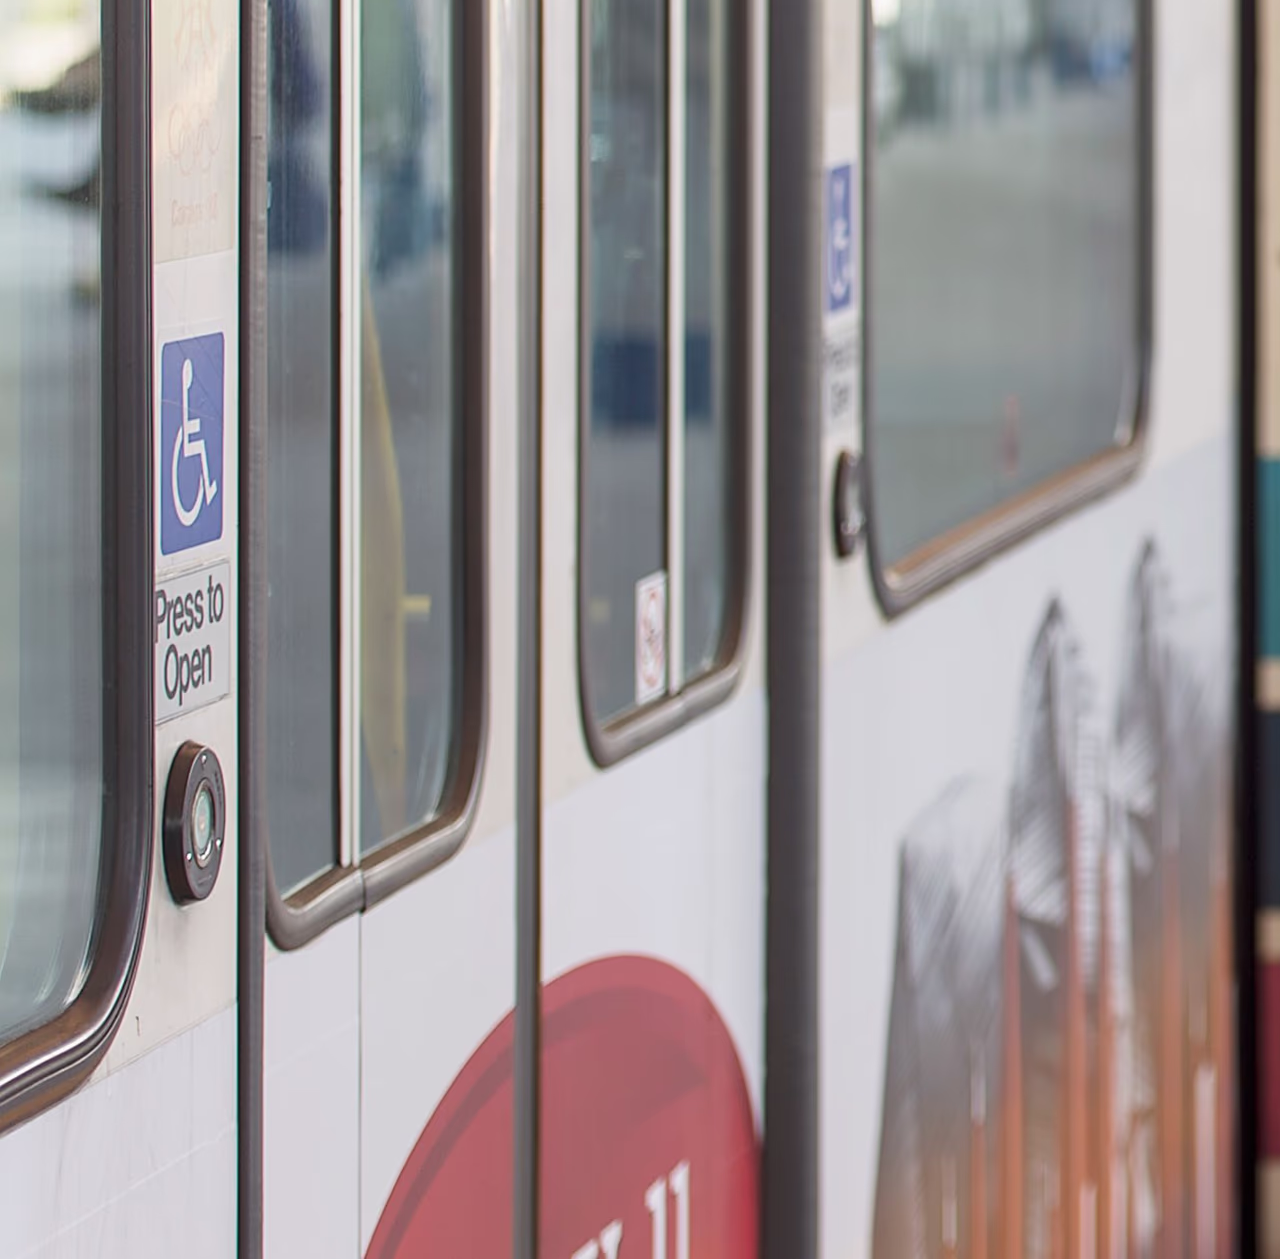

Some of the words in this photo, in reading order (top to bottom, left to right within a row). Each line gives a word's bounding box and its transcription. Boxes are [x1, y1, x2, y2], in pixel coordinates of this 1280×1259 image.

[154, 588, 204, 643] Press
[207, 574, 224, 623] to
[164, 643, 212, 706] Open
